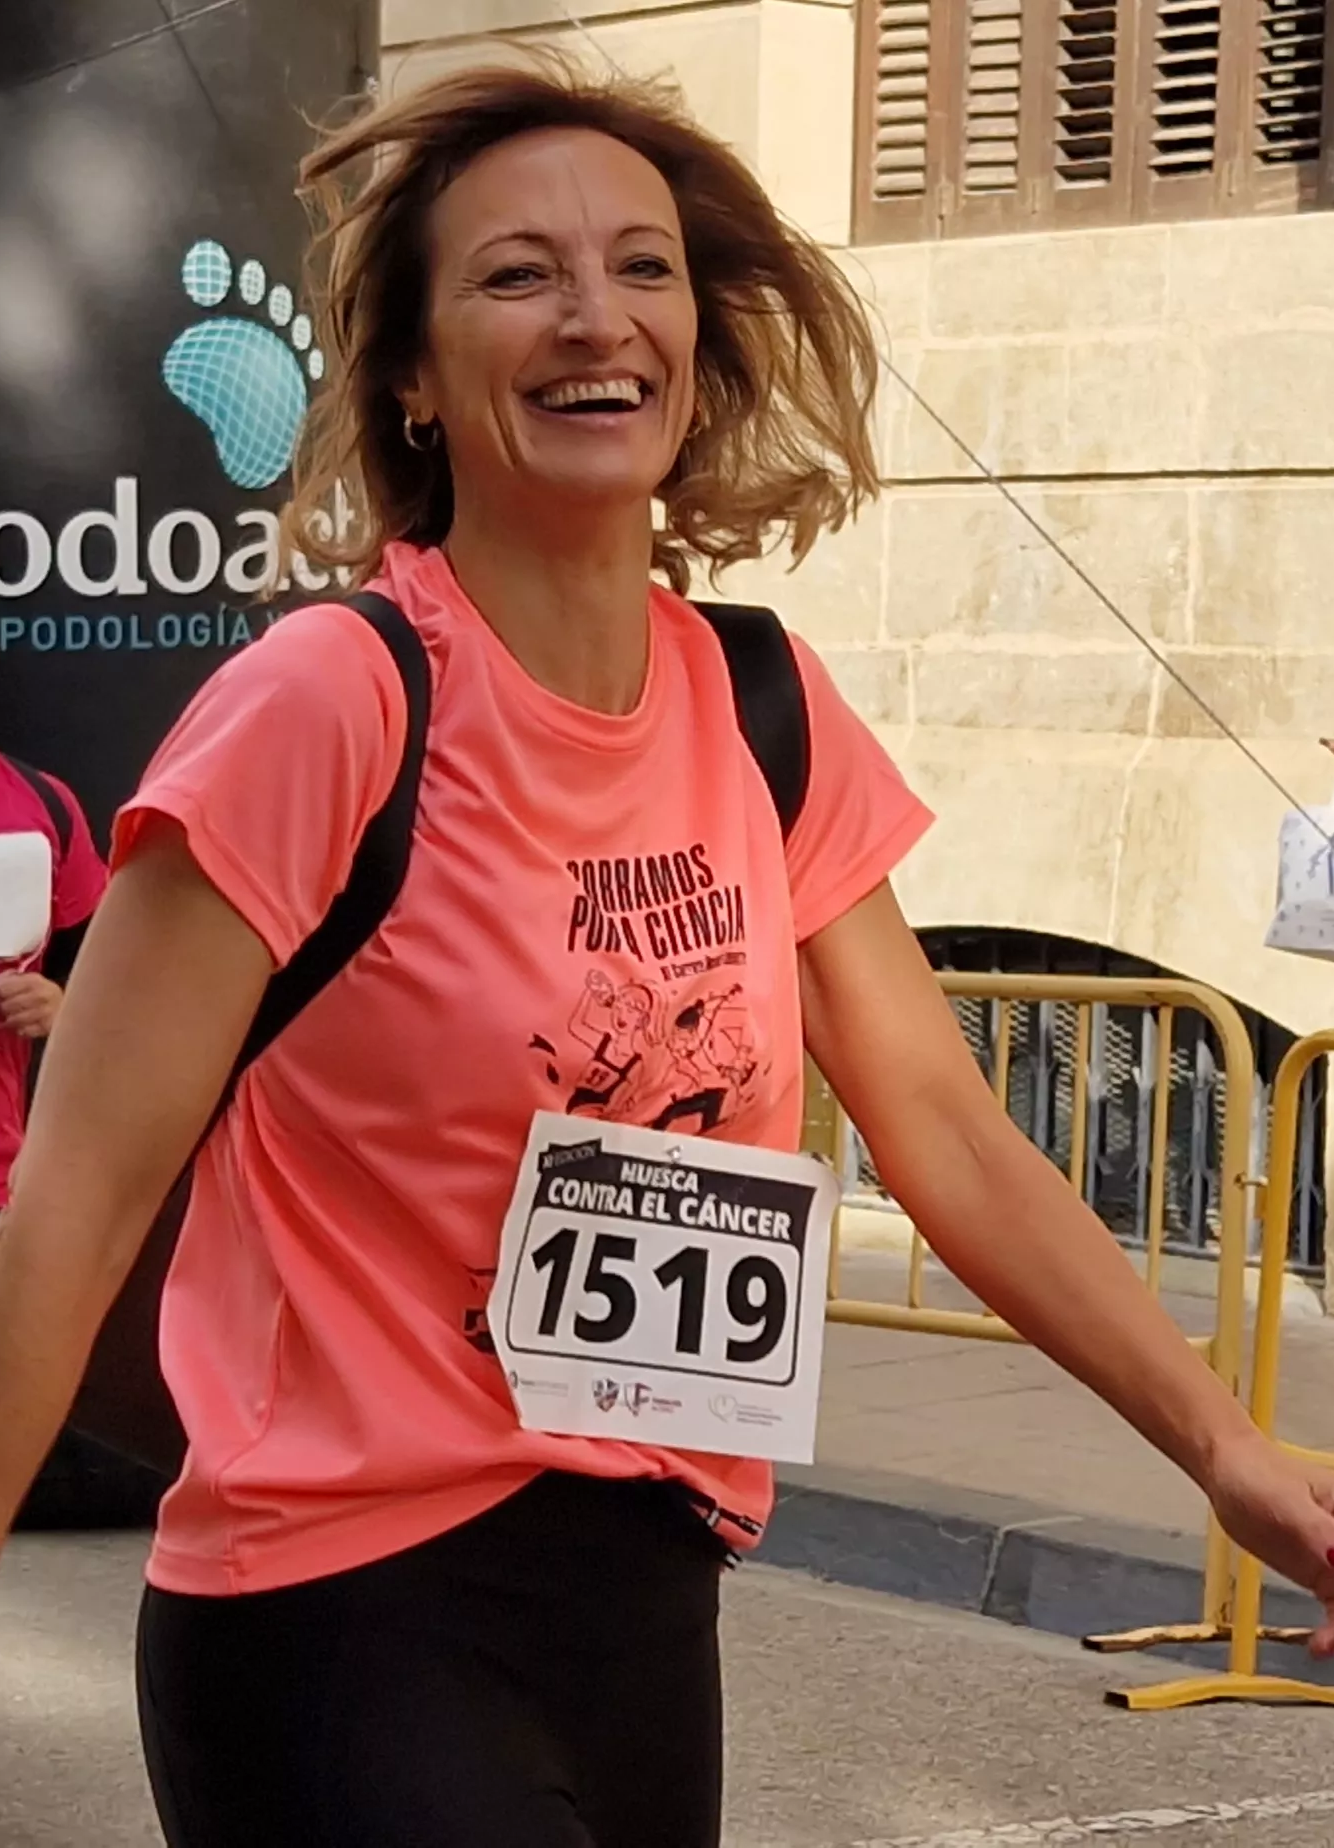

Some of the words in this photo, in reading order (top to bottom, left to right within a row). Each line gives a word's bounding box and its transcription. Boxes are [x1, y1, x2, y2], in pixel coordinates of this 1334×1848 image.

[0, 602, 254, 651] PODOLOGÍA
[644, 884, 745, 960] CIENCIA
[547, 1176, 634, 1217] CONTRA
[640, 1191, 672, 1222] EL
[679, 1193, 791, 1241] CÁNCER
[620, 1161, 699, 1194] HUESCA
[531, 1227, 788, 1363] 1519
